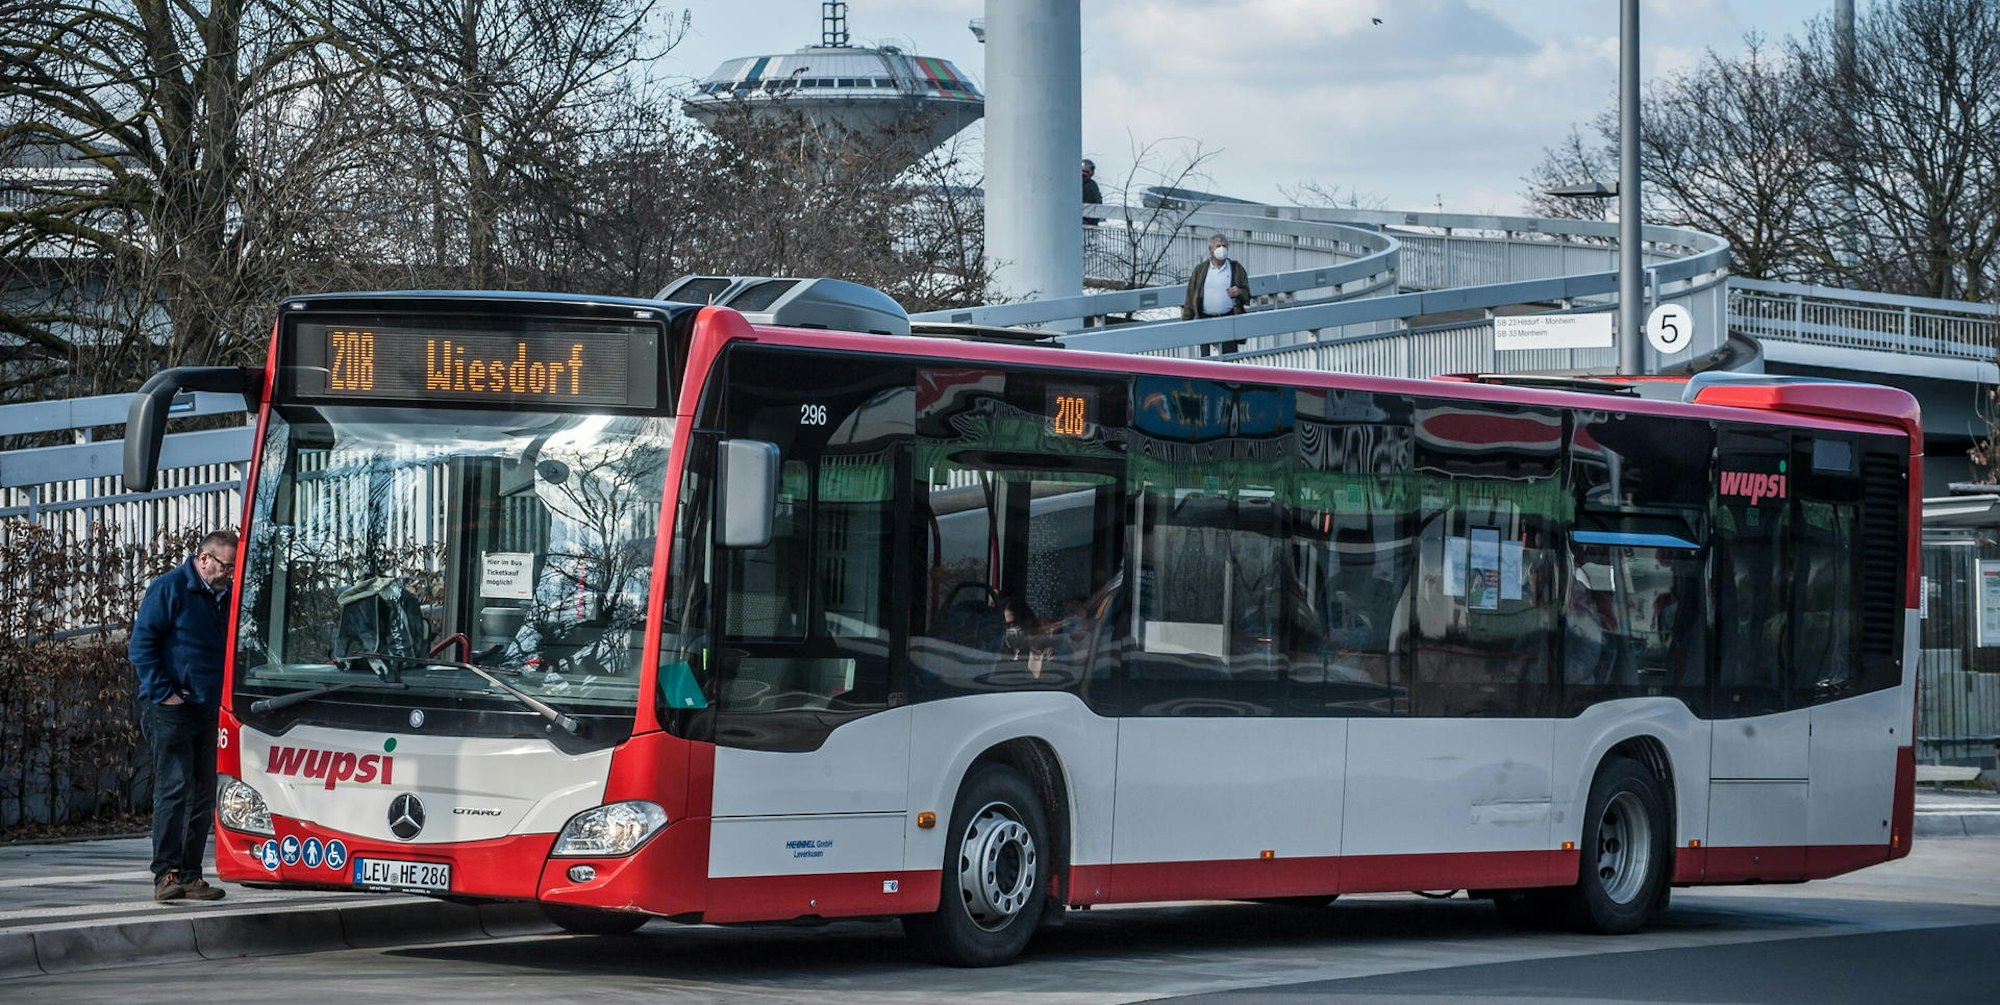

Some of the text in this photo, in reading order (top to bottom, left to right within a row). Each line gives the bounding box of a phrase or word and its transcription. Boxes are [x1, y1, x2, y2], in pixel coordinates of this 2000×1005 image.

[1496, 319, 1507, 327] SB
[1508, 319, 1517, 327] 23
[1545, 316, 1576, 325] Monheim
[1496, 329, 1548, 338] SB 33 Monheim
[1660, 313, 1679, 344] 5
[331, 331, 583, 395] 208 Wiesdorf
[800, 403, 827, 426] 296
[1055, 396, 1085, 435] 208
[1720, 460, 1787, 506] wupsi
[266, 737, 398, 790] wupsi
[453, 808, 502, 817] CITARO
[363, 862, 390, 882] LEV
[400, 864, 417, 884] HE
[421, 866, 447, 886] 286
